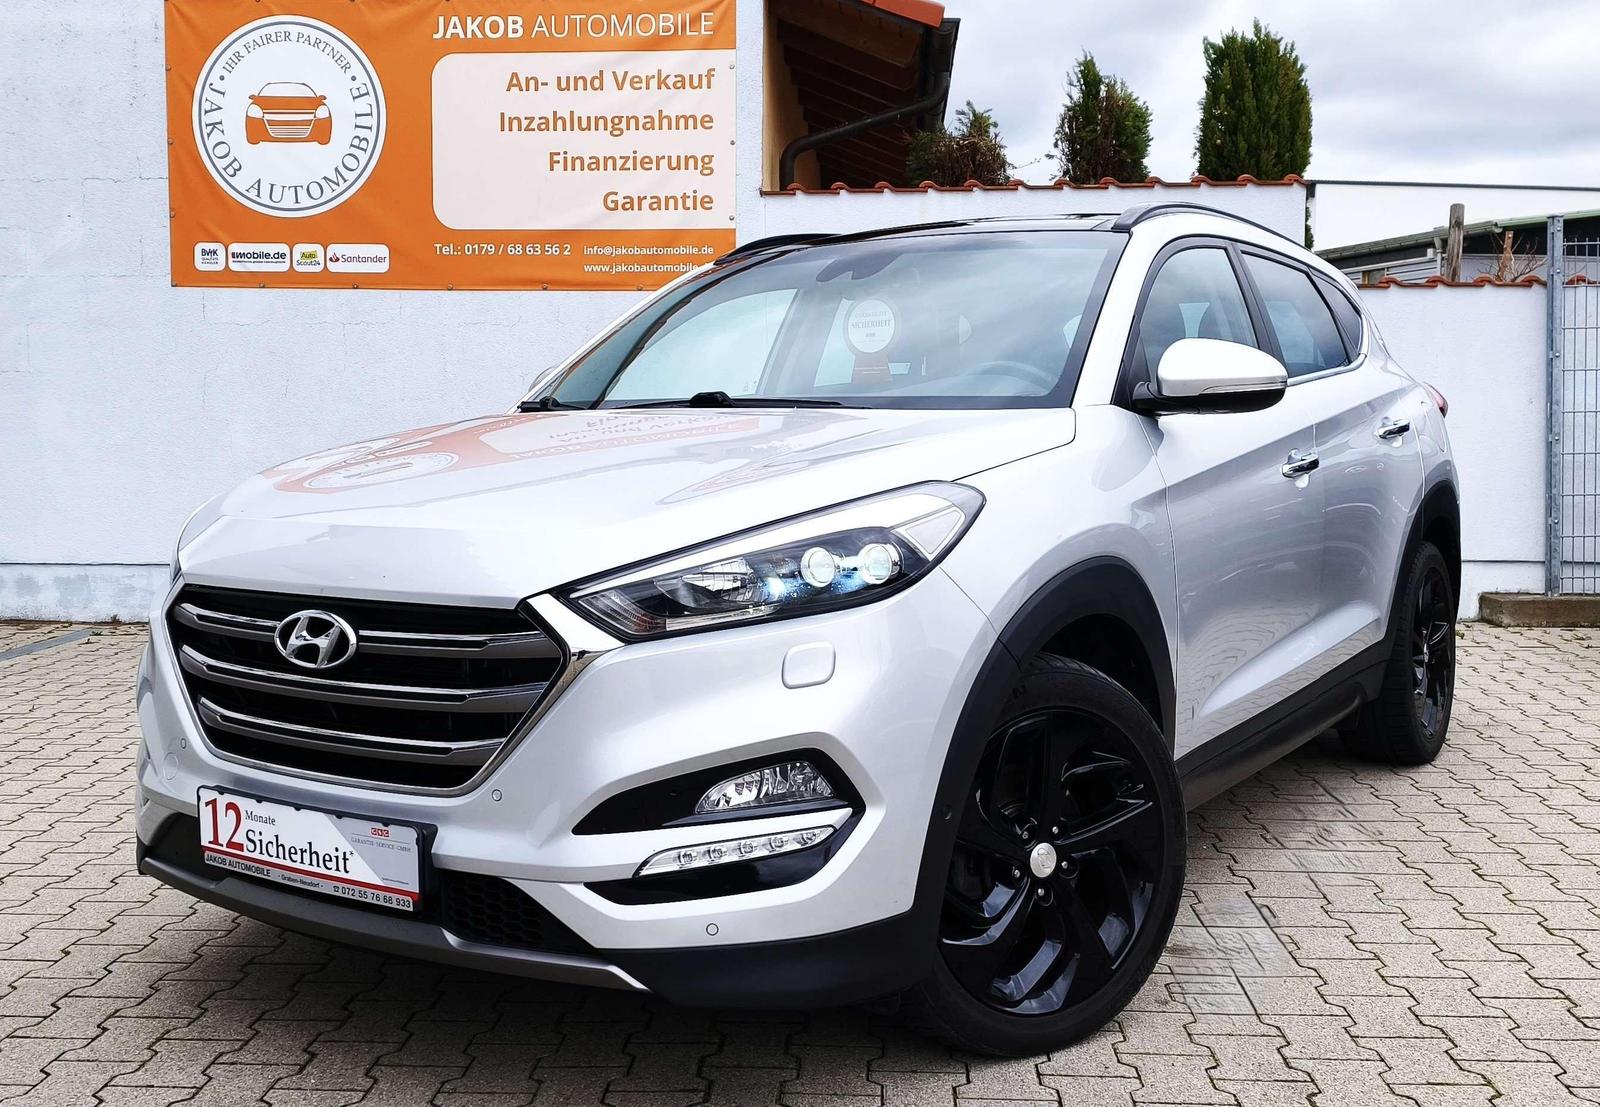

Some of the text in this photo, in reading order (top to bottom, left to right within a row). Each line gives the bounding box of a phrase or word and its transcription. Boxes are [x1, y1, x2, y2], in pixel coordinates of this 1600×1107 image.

[432, 12, 714, 39] JAKOB AUTOMOBILE
[222, 30, 352, 74] IHR FAIRER PARTNER
[506, 68, 716, 92] An- und Verkauf
[499, 110, 714, 137] Inzahlungnahme
[204, 82, 374, 204] JAKOB AUTOMOBILE
[548, 150, 714, 176] Finanzierung
[602, 189, 714, 212] Garantie
[232, 251, 287, 260] mobile.de
[341, 254, 387, 263] Santander
[434, 243, 571, 255] Tel.: 0179 / 68 63 56 2
[583, 245, 714, 257] info@jakobautomobile.de
[583, 262, 699, 274] www.jakobautomobile
[204, 798, 244, 852] 12
[245, 810, 276, 826] Monate
[206, 853, 227, 865] JAKOB
[228, 860, 271, 877] AUTOMOBILE
[341, 886, 356, 897] 072
[358, 891, 368, 899] 55
[371, 892, 380, 902] 76
[383, 895, 393, 904] 68
[395, 898, 411, 908] 933
